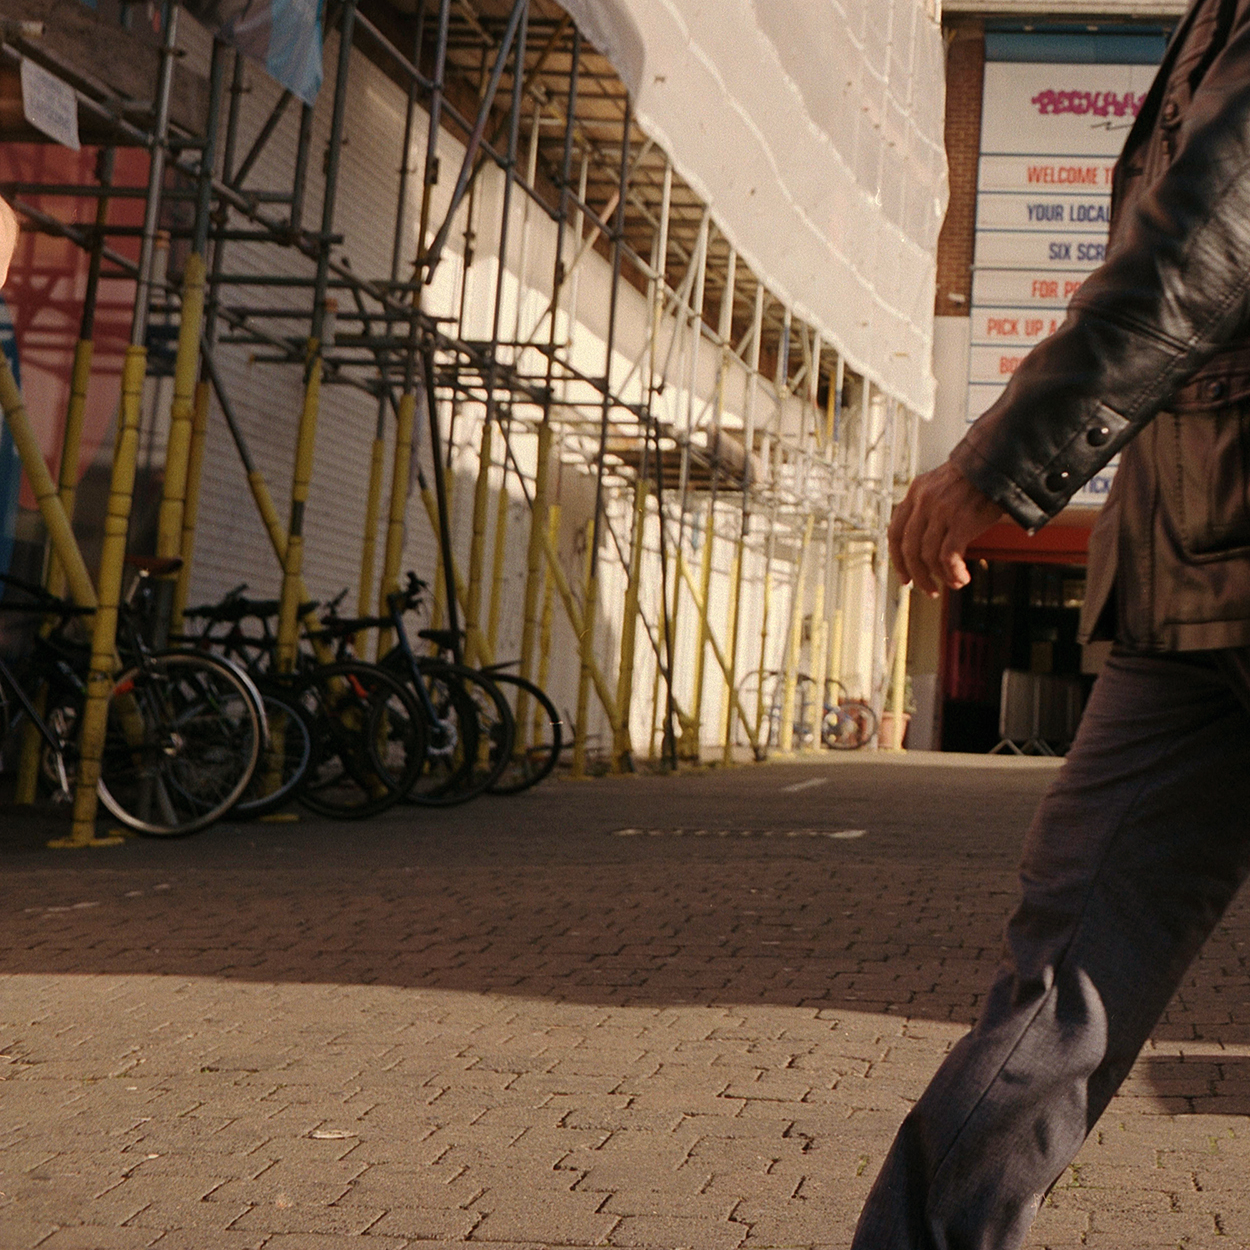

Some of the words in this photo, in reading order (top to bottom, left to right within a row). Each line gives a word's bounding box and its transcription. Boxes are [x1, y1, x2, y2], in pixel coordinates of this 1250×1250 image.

[1027, 166, 1097, 184] WELCOME
[1026, 204, 1064, 222] YOUR
[1049, 242, 1072, 261] SIX
[1077, 243, 1108, 261] SCR
[1032, 280, 1058, 299] FOR
[987, 317, 1018, 336] PICK
[1025, 318, 1044, 337] UP
